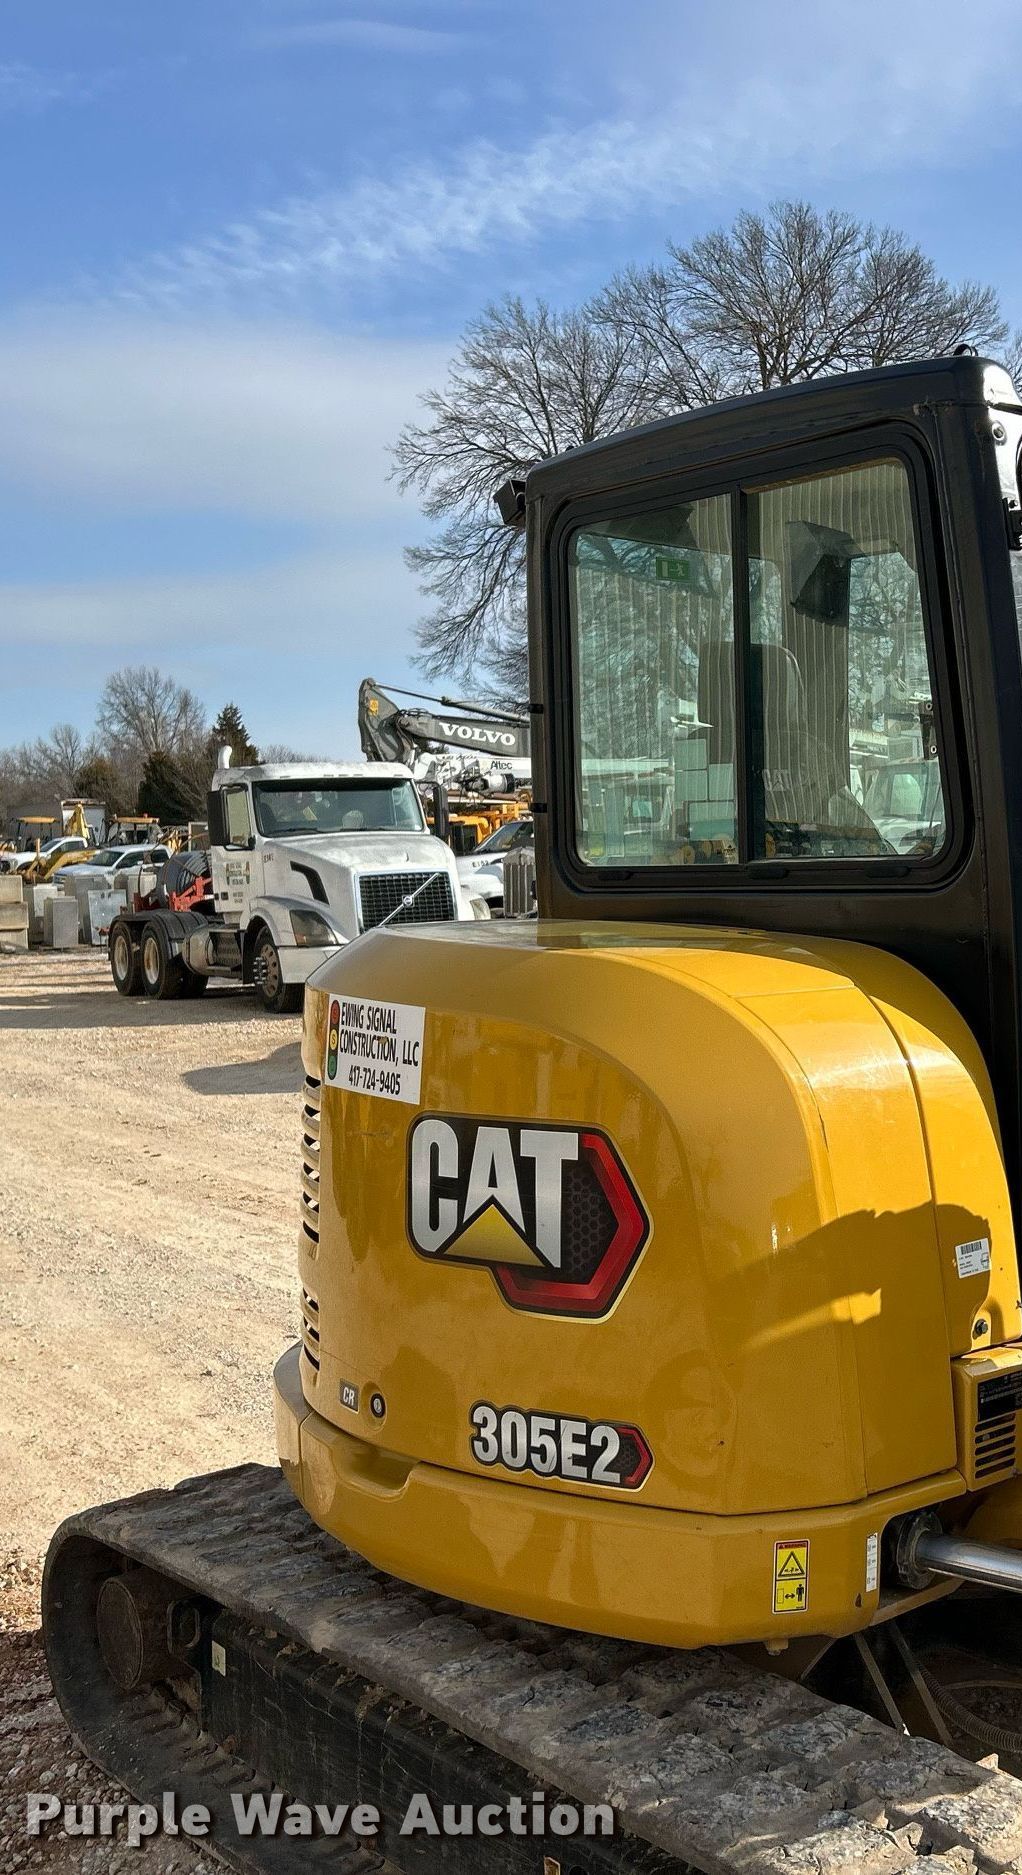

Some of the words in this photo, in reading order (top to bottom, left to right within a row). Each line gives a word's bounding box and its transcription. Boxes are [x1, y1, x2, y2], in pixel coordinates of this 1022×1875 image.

[439, 722, 516, 746] VOLVO
[490, 760, 513, 770] Altec
[341, 1002, 365, 1029] EWING
[366, 1006, 397, 1034] SIGNAL
[339, 1029, 399, 1066] CONSTRUCTION,
[402, 1039, 420, 1067] LLC
[348, 1064, 401, 1096] 417-724-9405
[411, 1119, 579, 1269] CAT
[342, 1386, 355, 1407] CR
[472, 1405, 621, 1484] 305E2
